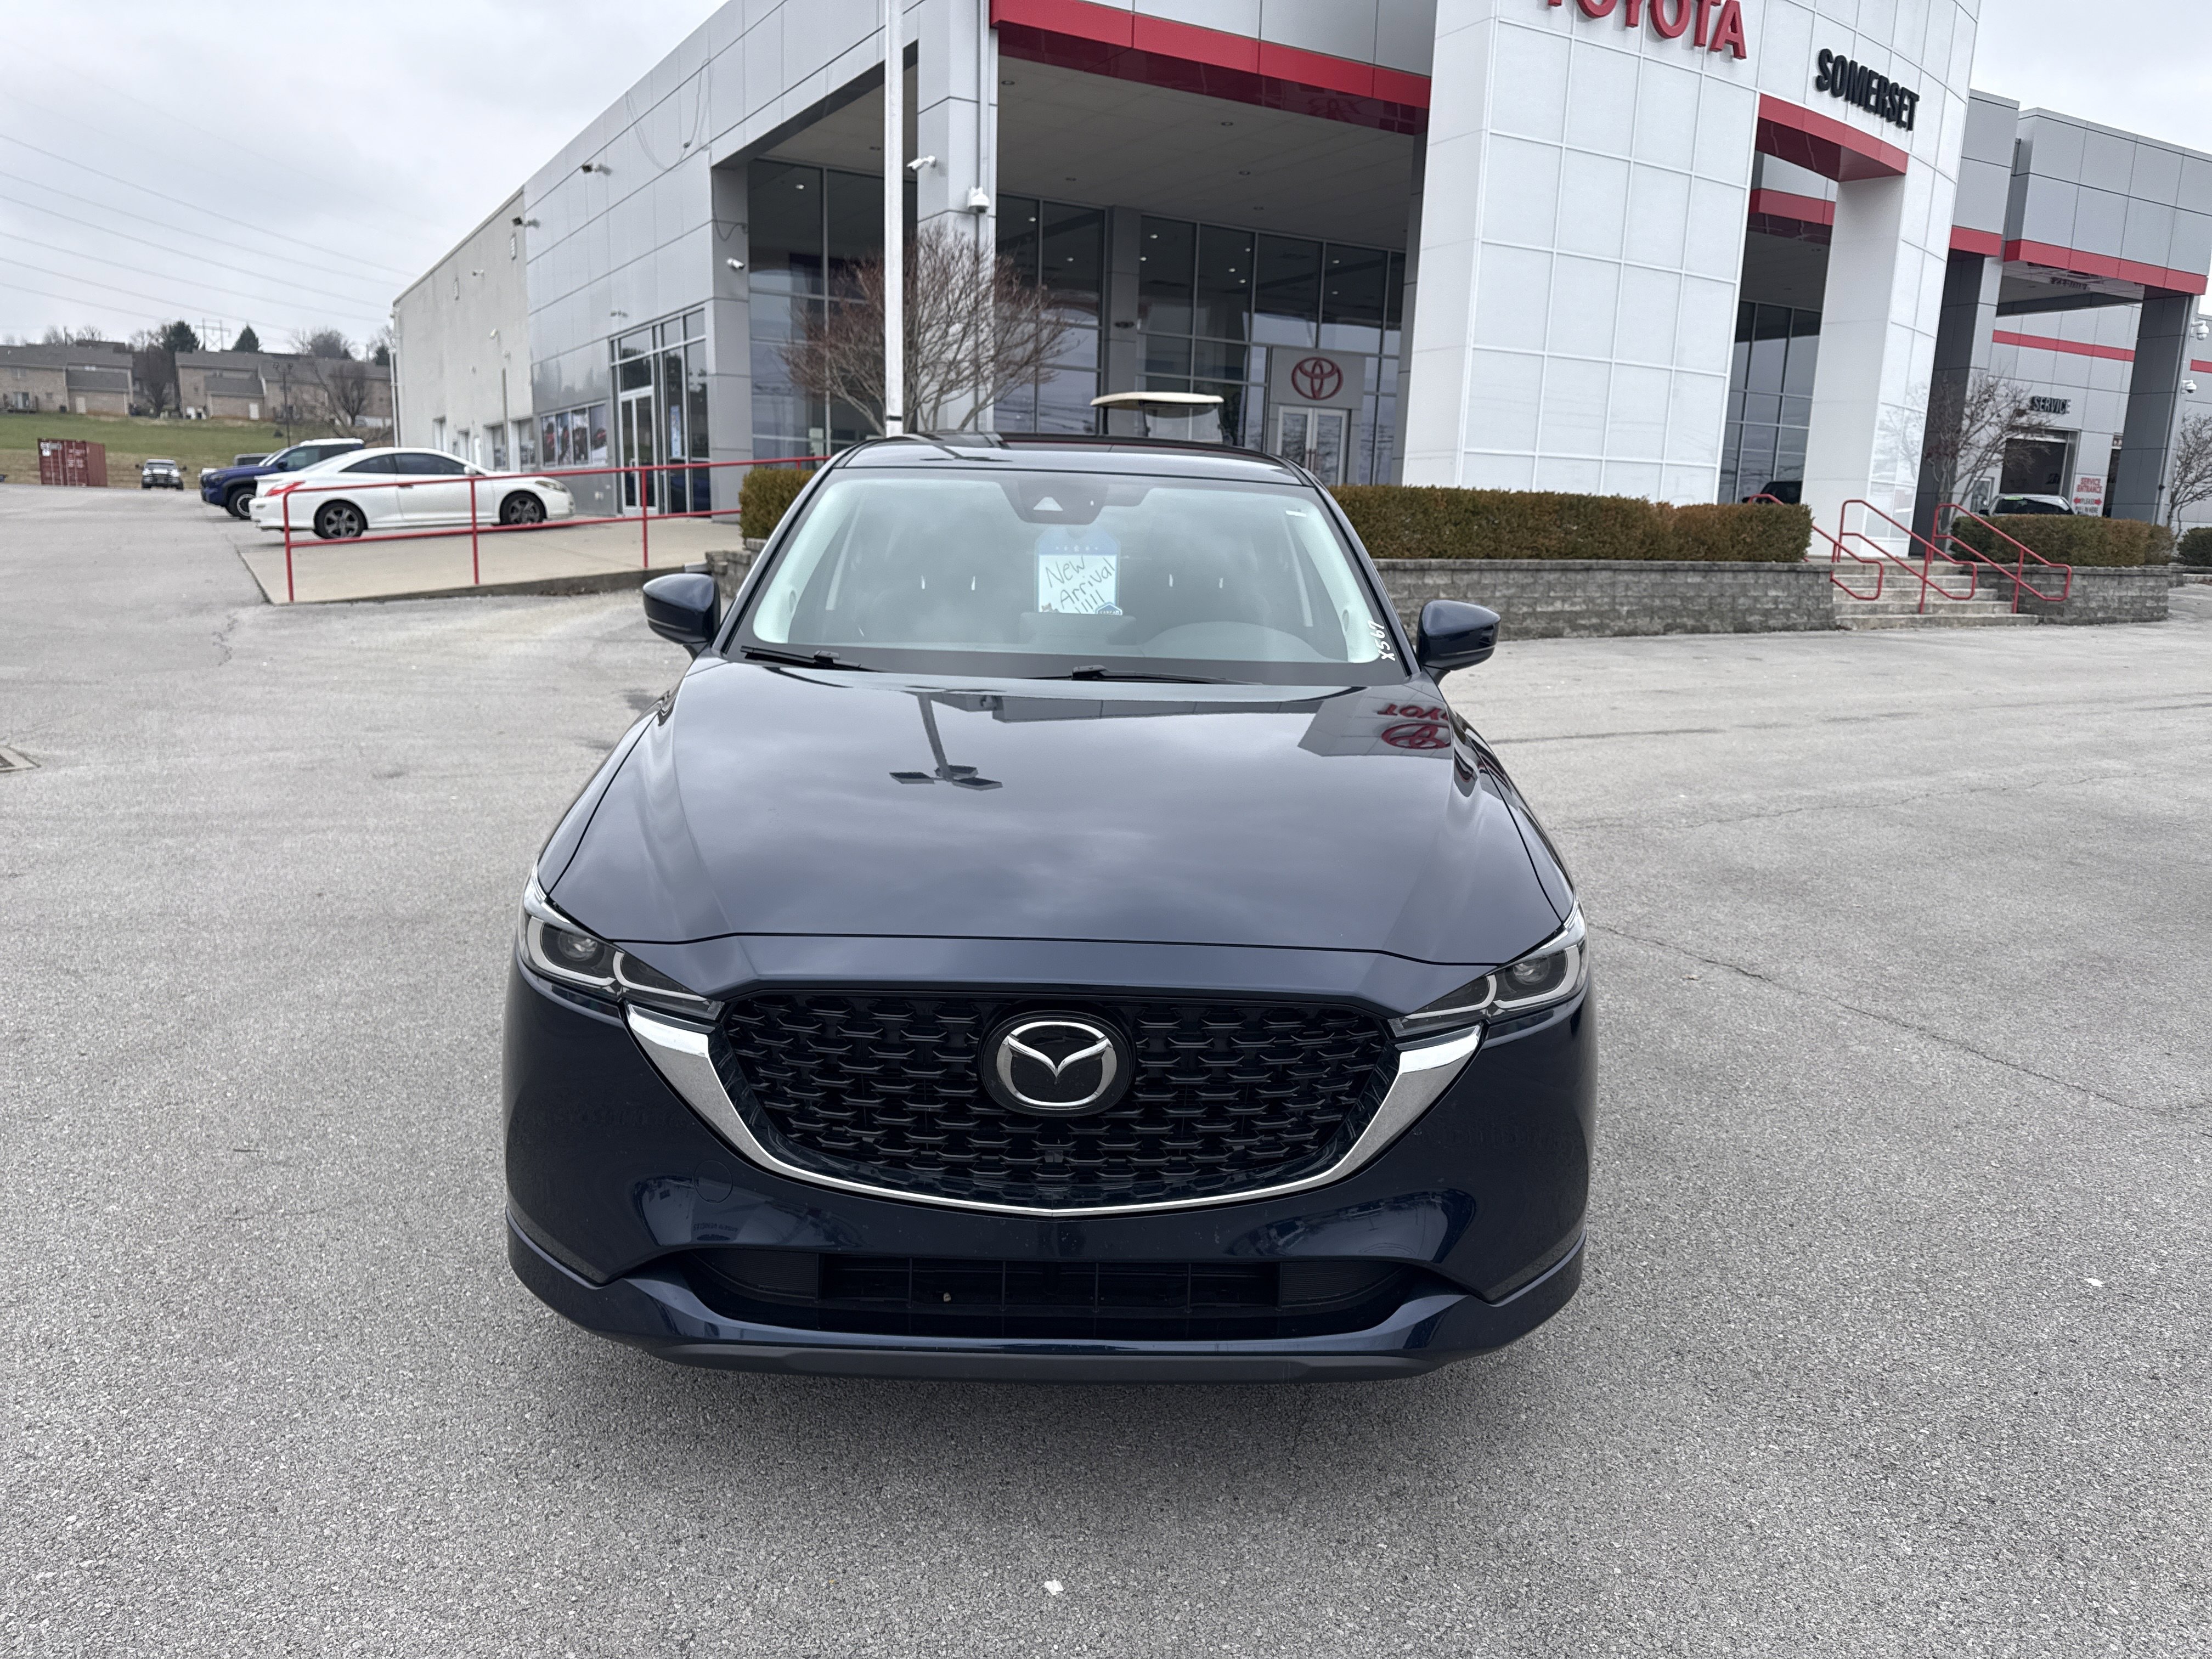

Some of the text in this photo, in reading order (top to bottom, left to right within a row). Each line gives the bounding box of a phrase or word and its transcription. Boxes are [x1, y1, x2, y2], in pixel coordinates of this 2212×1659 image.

[1816, 48, 1920, 131] SOMERSET
[2033, 396, 2071, 414] SERVICE
[2076, 484, 2102, 493] ENTRANCE
[2080, 477, 2101, 486] SERVICE
[1045, 556, 1085, 588] New
[1060, 557, 1115, 610] Arrival
